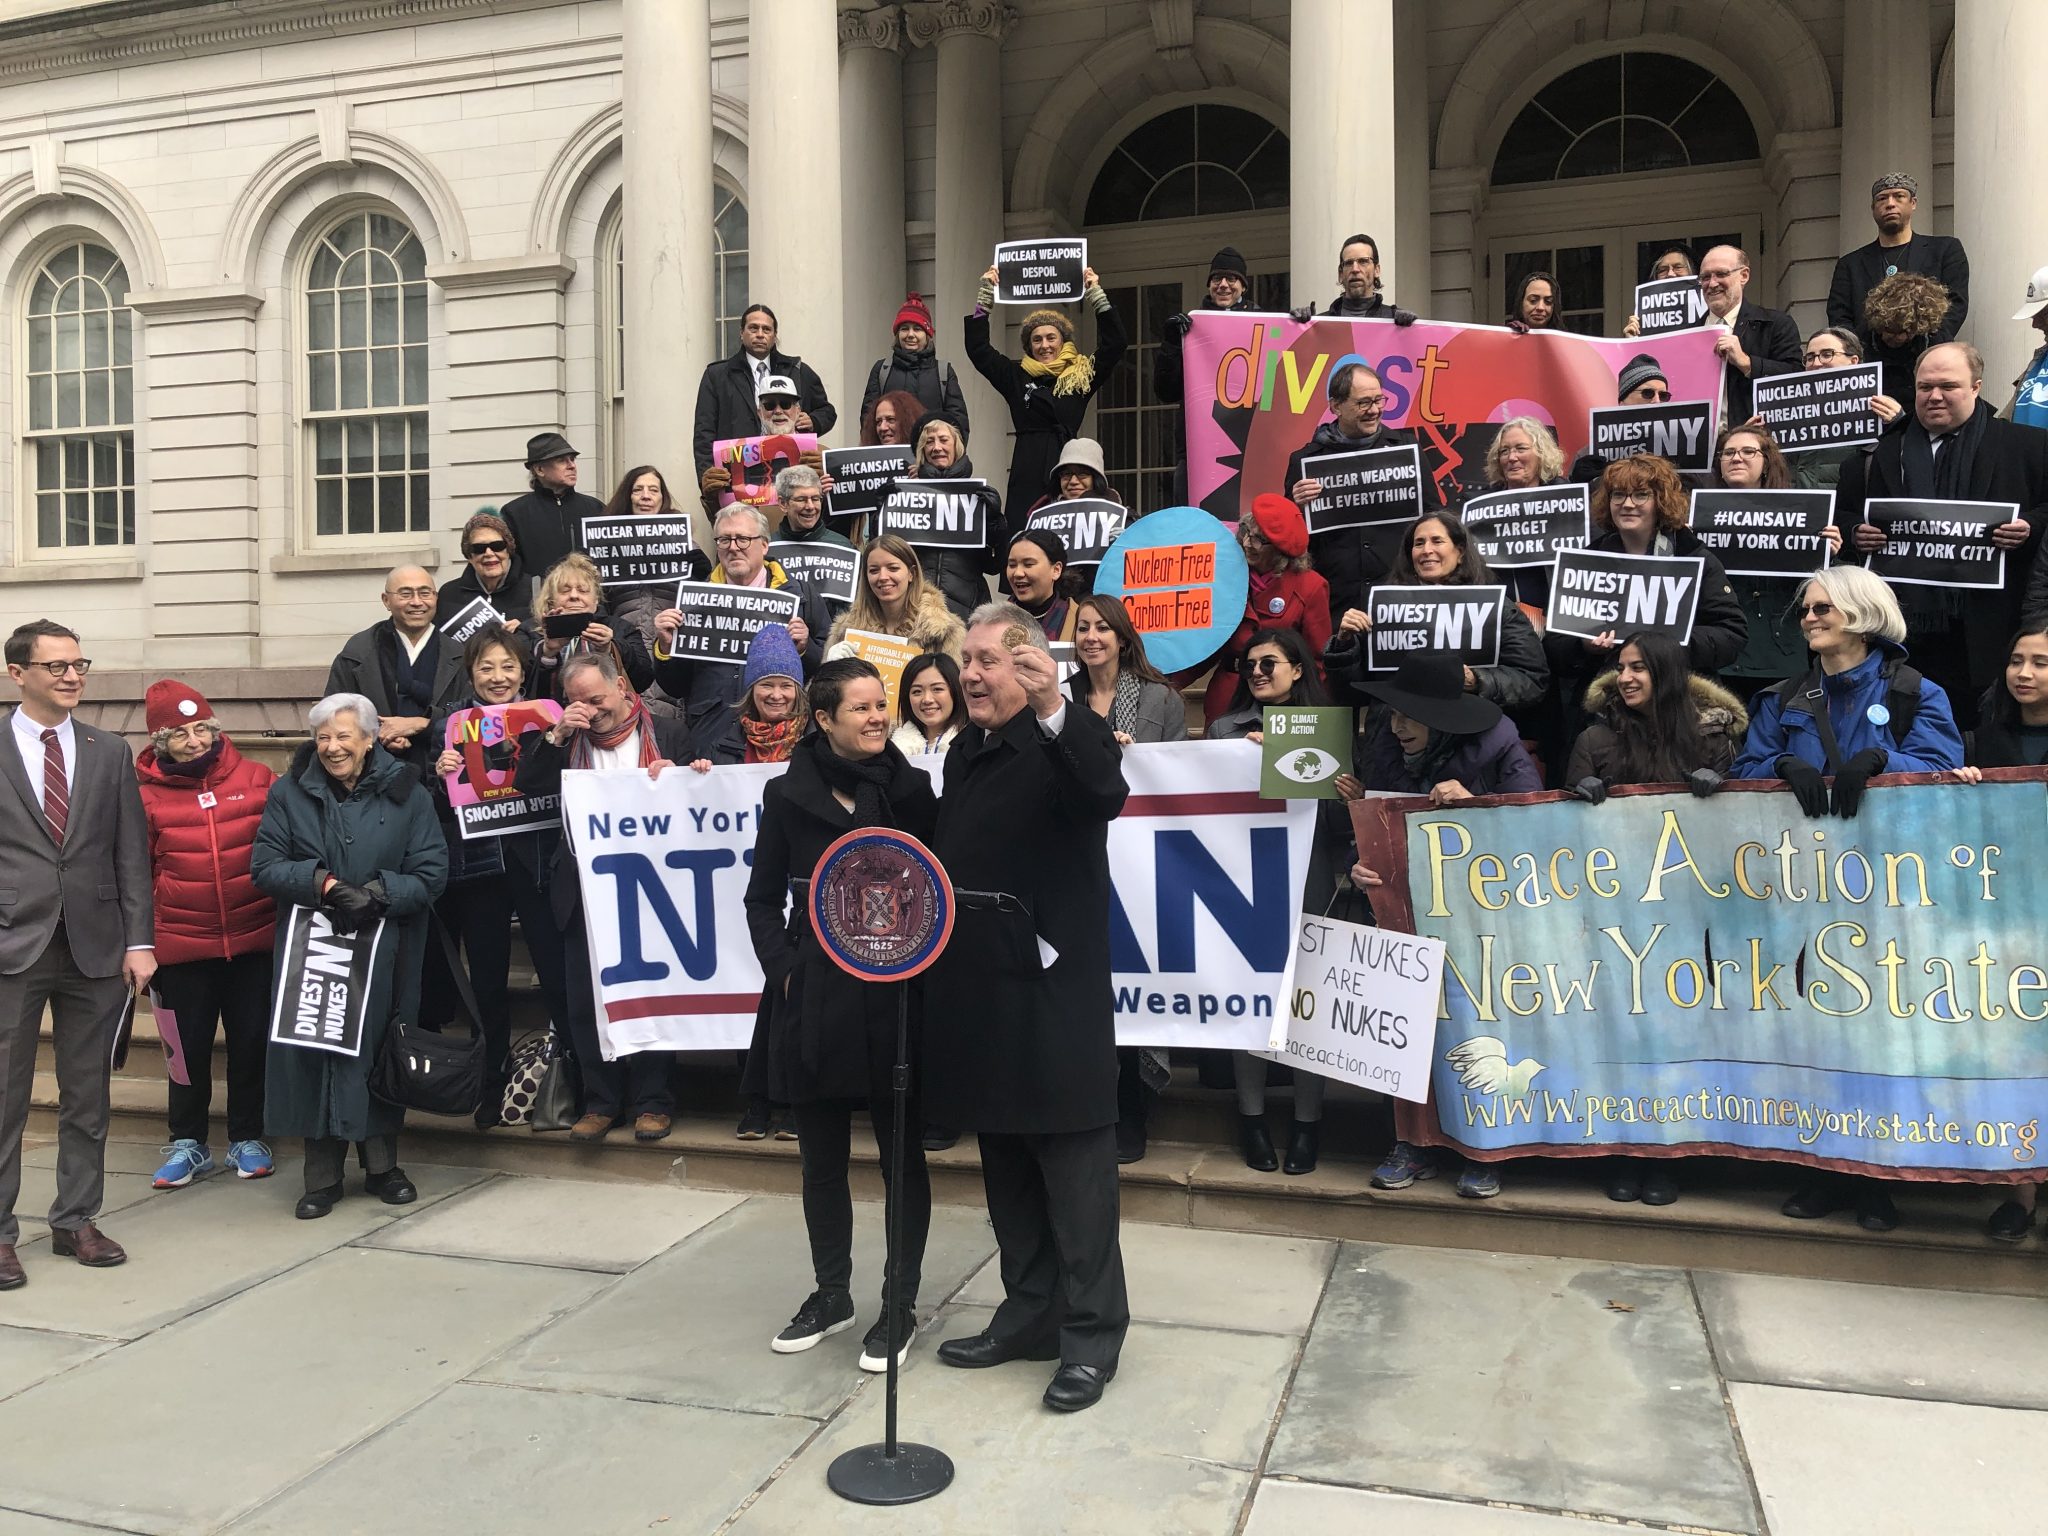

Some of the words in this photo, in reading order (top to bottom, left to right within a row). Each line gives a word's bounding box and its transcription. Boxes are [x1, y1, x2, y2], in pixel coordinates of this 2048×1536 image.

[999, 250, 1037, 262] NUCLEAR
[1039, 248, 1081, 260] WEAPONS
[1022, 266, 1057, 278] DESPOIL
[1013, 284, 1042, 296] NATIVE
[1044, 283, 1071, 295] LANDS
[1641, 290, 1686, 310] DIVEST
[1687, 288, 1709, 324] N
[1641, 310, 1683, 329] NUKES
[1758, 383, 1811, 403] NUCLEAR
[1814, 373, 1876, 395] WEAPONS
[1759, 403, 1820, 424] THREATEN
[1597, 421, 1652, 443] DIVEST
[1653, 416, 1705, 456] NY
[1771, 419, 1875, 444] ATASTROPHE
[1598, 443, 1647, 462] NUKES
[840, 458, 904, 476] #ICANSAVE
[1313, 473, 1359, 489] UCLEAR
[1361, 464, 1416, 485] WEAPONS
[832, 481, 856, 495] NEW
[887, 492, 936, 508] DIVEST
[1310, 497, 1333, 513] KILL
[1336, 486, 1416, 508] EVERYTHING
[1467, 503, 1520, 522] NUCLEAR
[1523, 497, 1584, 516] WEAPONS
[886, 512, 931, 530] NUKES
[935, 493, 979, 531] NY
[1031, 513, 1075, 530] DIVEST
[1713, 511, 1807, 528] #ICANSAVE
[587, 525, 633, 540] NUCLEAR
[635, 523, 687, 538] WEAPONS
[1074, 511, 1121, 550] NY
[1494, 519, 1548, 538] TARGET
[1890, 520, 1987, 538] #ICANSAVE
[589, 546, 609, 558] ARE
[611, 545, 619, 557] A
[620, 544, 643, 557] WAR
[646, 542, 688, 555] AGAINST
[1474, 542, 1499, 556] EW
[1506, 539, 1545, 555] YORK
[1551, 536, 1585, 551] CITY
[1736, 533, 1780, 550] YORK
[1784, 534, 1821, 551] CITY
[1915, 542, 1957, 560] YORK
[1960, 545, 1996, 562] CITY
[593, 564, 620, 578] HE
[629, 561, 688, 576] FUTURE
[804, 555, 854, 570] WEAPONS
[1123, 546, 1212, 585] Nuclear-Free
[814, 568, 851, 582] CITIES
[1562, 567, 1630, 595] DIVEST
[681, 592, 733, 609] NUCLEAR
[736, 595, 793, 615] WEAPONS
[1123, 590, 1210, 630] Carbon-Free
[1559, 595, 1619, 622] NUKES
[1625, 574, 1693, 625] NY
[681, 612, 702, 628] ARE
[704, 614, 713, 629] A
[715, 615, 740, 631] WAR
[1377, 603, 1437, 624] DIVEST
[1434, 602, 1496, 650] NY
[679, 634, 709, 650] THE
[720, 638, 750, 655] FUT
[1377, 629, 1428, 651] NUKES
[1269, 714, 1287, 735] 13
[1290, 714, 1318, 724] CLIMATE
[1290, 725, 1315, 735] ACTION
[483, 789, 499, 798] new
[501, 786, 514, 797] yor
[529, 793, 561, 811] LEAR
[465, 799, 527, 823] WEAPONS
[588, 812, 671, 840] New
[1418, 820, 1621, 918] Peace
[1638, 810, 1937, 907] Action
[1949, 843, 2002, 901] of
[305, 911, 358, 978] NY
[869, 941, 893, 950] 1625
[1299, 922, 1334, 956] ST
[1350, 932, 1430, 983] NUKES
[1323, 966, 1365, 997] ARE
[1426, 934, 1603, 1022] New
[1598, 923, 1791, 1015] York
[1807, 921, 2048, 1024] State
[294, 969, 324, 1037] DIVEST
[323, 981, 348, 1041] NUKES
[1291, 988, 1315, 1021] NO
[1331, 997, 1408, 1050] NUKES
